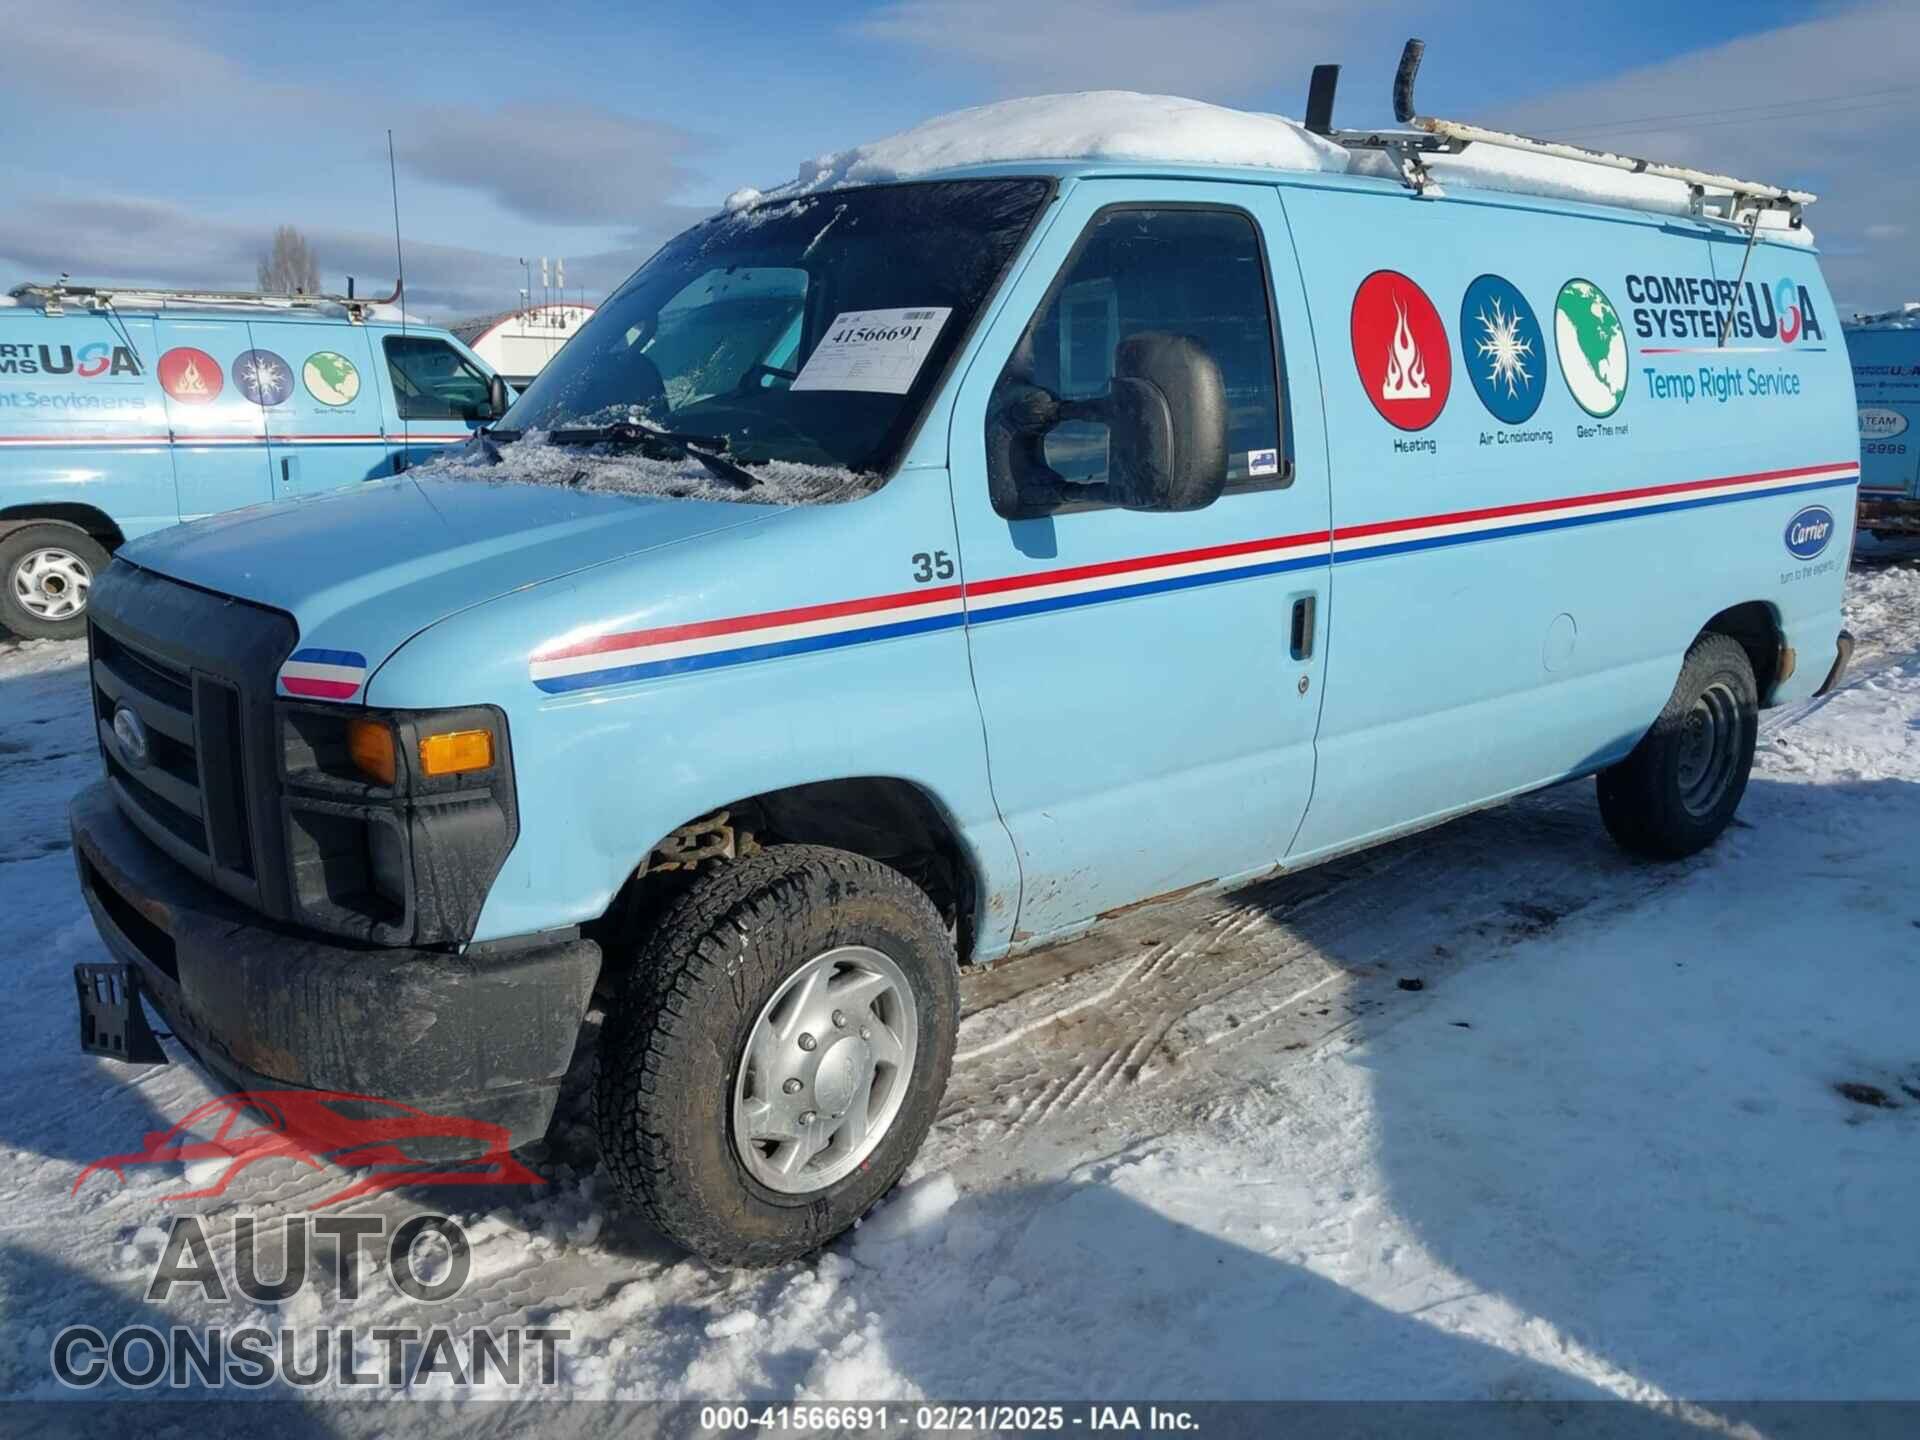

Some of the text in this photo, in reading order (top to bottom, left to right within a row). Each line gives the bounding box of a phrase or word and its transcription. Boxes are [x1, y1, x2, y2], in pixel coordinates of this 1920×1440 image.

[1625, 274, 1745, 306] COMFORT
[1633, 308, 1754, 339] SYSTEMS
[1745, 277, 1823, 344] USA
[832, 325, 922, 344] 41566691
[38, 341, 140, 377] USA
[1643, 366, 1800, 404] Temp Right Service
[1866, 416, 1897, 425] TEAM
[1393, 436, 1437, 454] Heating
[1480, 431, 1494, 446] Air
[1791, 519, 1829, 546] Carrier
[911, 550, 955, 583] 35
